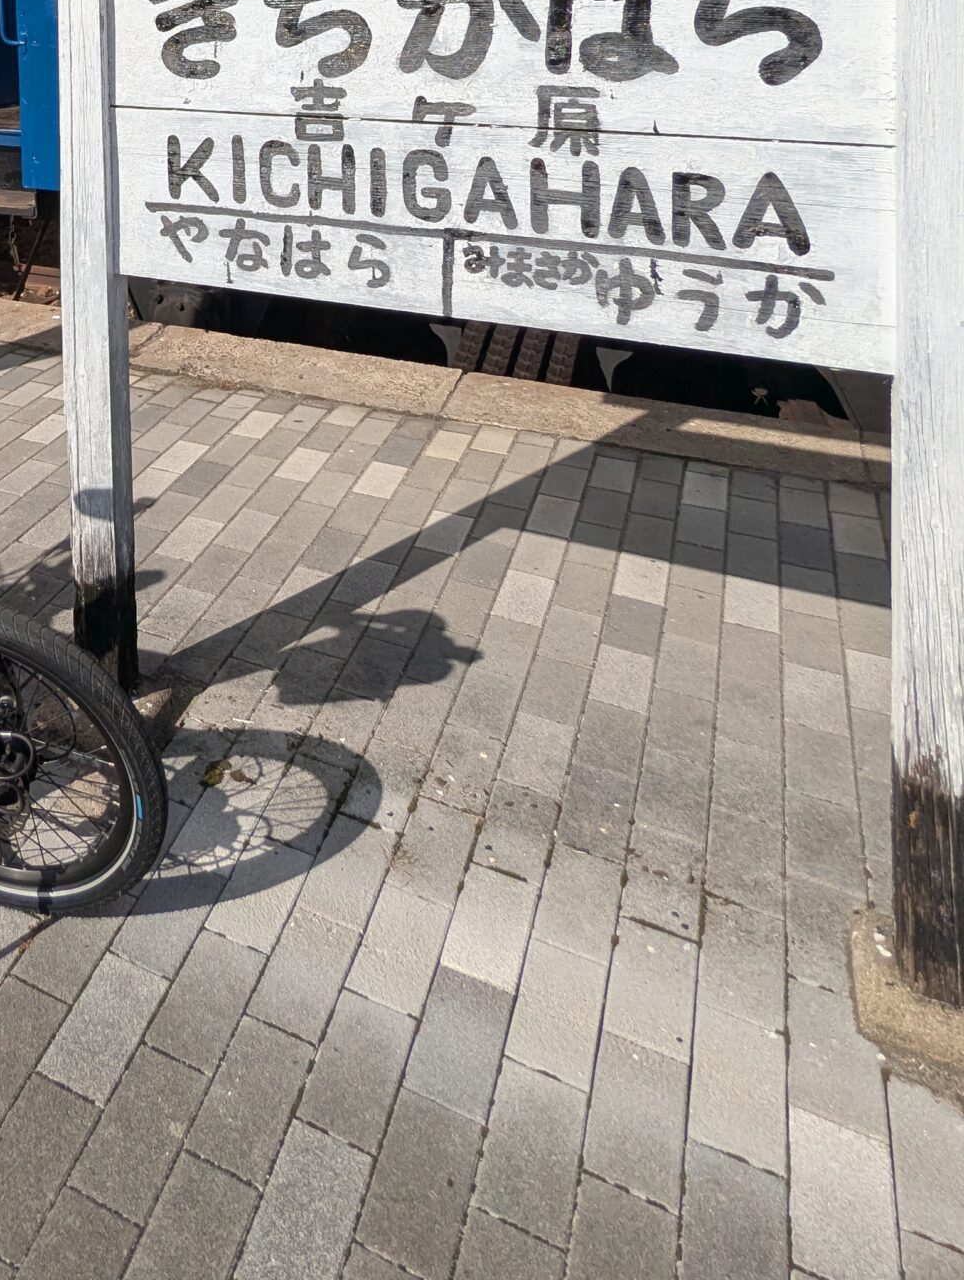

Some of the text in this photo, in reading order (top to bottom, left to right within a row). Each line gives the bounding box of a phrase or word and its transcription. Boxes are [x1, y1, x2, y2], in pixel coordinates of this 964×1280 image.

[167, 134, 811, 257] KICHIGAHARA
[160, 215, 391, 289] やなはら
